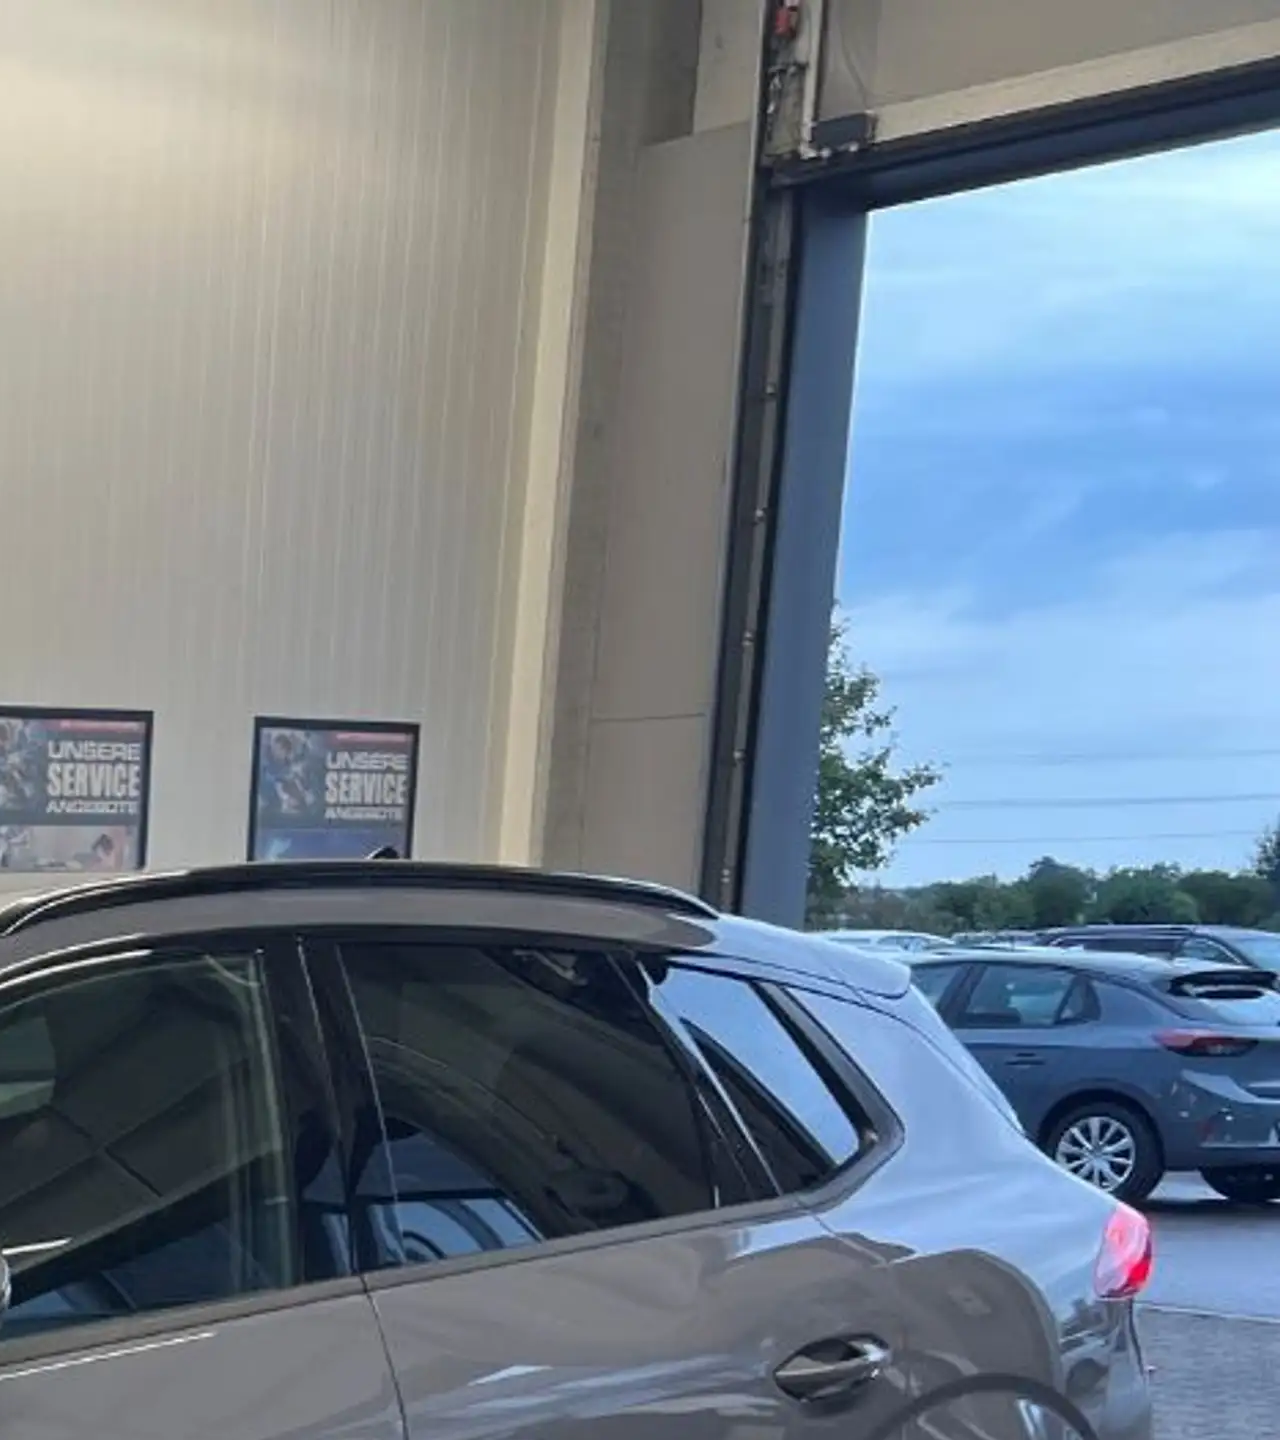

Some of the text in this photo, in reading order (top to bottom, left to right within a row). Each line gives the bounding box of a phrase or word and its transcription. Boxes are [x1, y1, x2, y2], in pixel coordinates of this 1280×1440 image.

[47, 740, 141, 761] UNSERE
[46, 763, 141, 798] SERVICE
[325, 772, 407, 805] SERVICE
